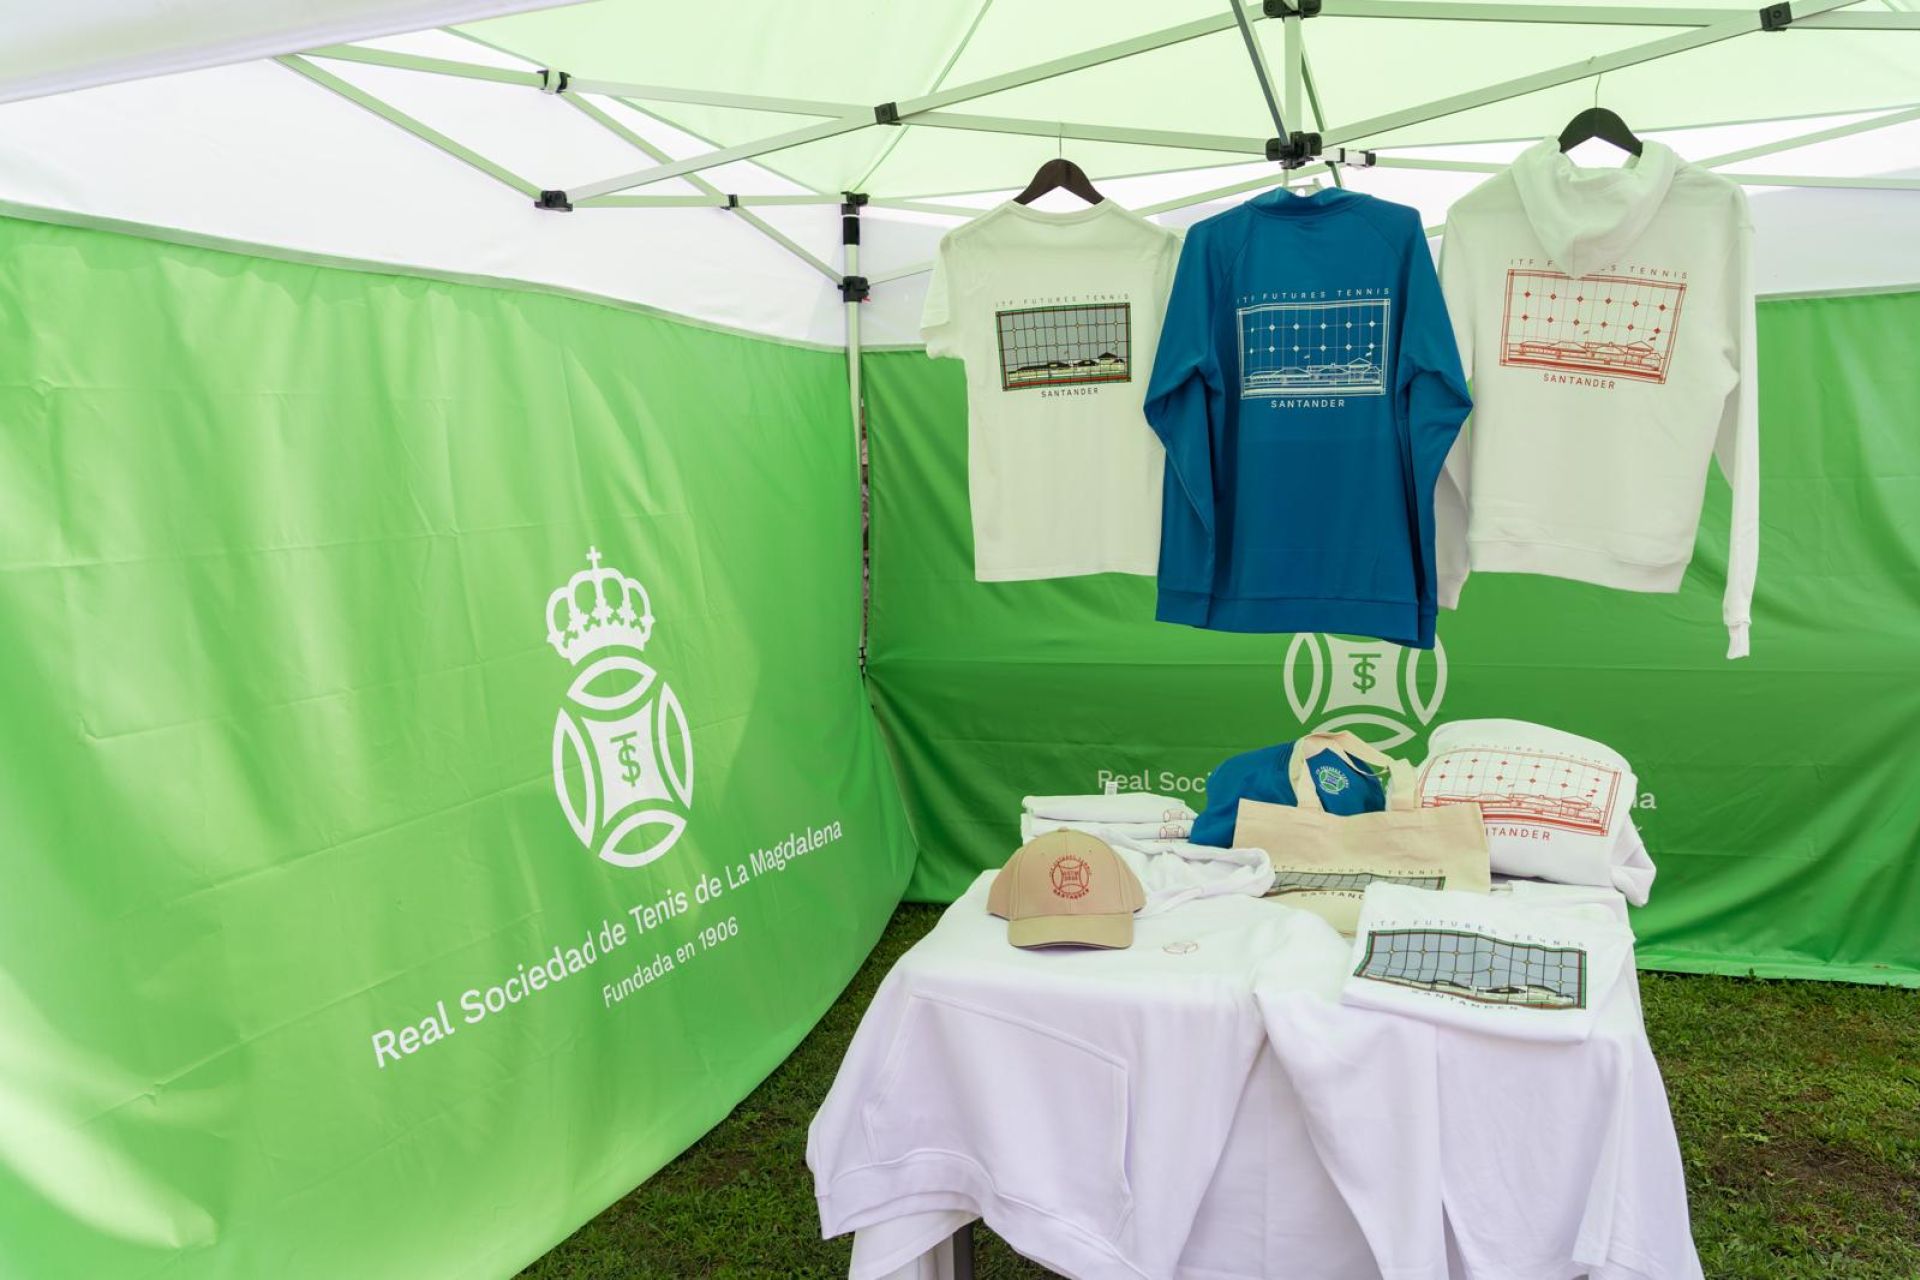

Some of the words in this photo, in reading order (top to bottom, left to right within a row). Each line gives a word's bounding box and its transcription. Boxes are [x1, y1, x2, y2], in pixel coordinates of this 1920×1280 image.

[1509, 258, 1535, 267] ITF
[1629, 265, 1688, 280] TENNIS
[1262, 291, 1327, 301] FUTURES
[1337, 287, 1390, 297] TENNIS
[1543, 373, 1616, 391] SANTANDER
[1041, 387, 1100, 399] SANTANDER
[1270, 399, 1346, 409] SANTANDER
[1097, 769, 1153, 791] Real
[371, 1001, 456, 1069] Real
[460, 931, 598, 1025] Sociedad
[598, 919, 628, 954] de
[628, 889, 689, 937] Tenis
[694, 873, 723, 905] de
[725, 864, 750, 891] La
[750, 820, 843, 878] Magdalena
[602, 949, 675, 1009] Fundada
[675, 940, 696, 962] en
[699, 916, 740, 950] 1906
